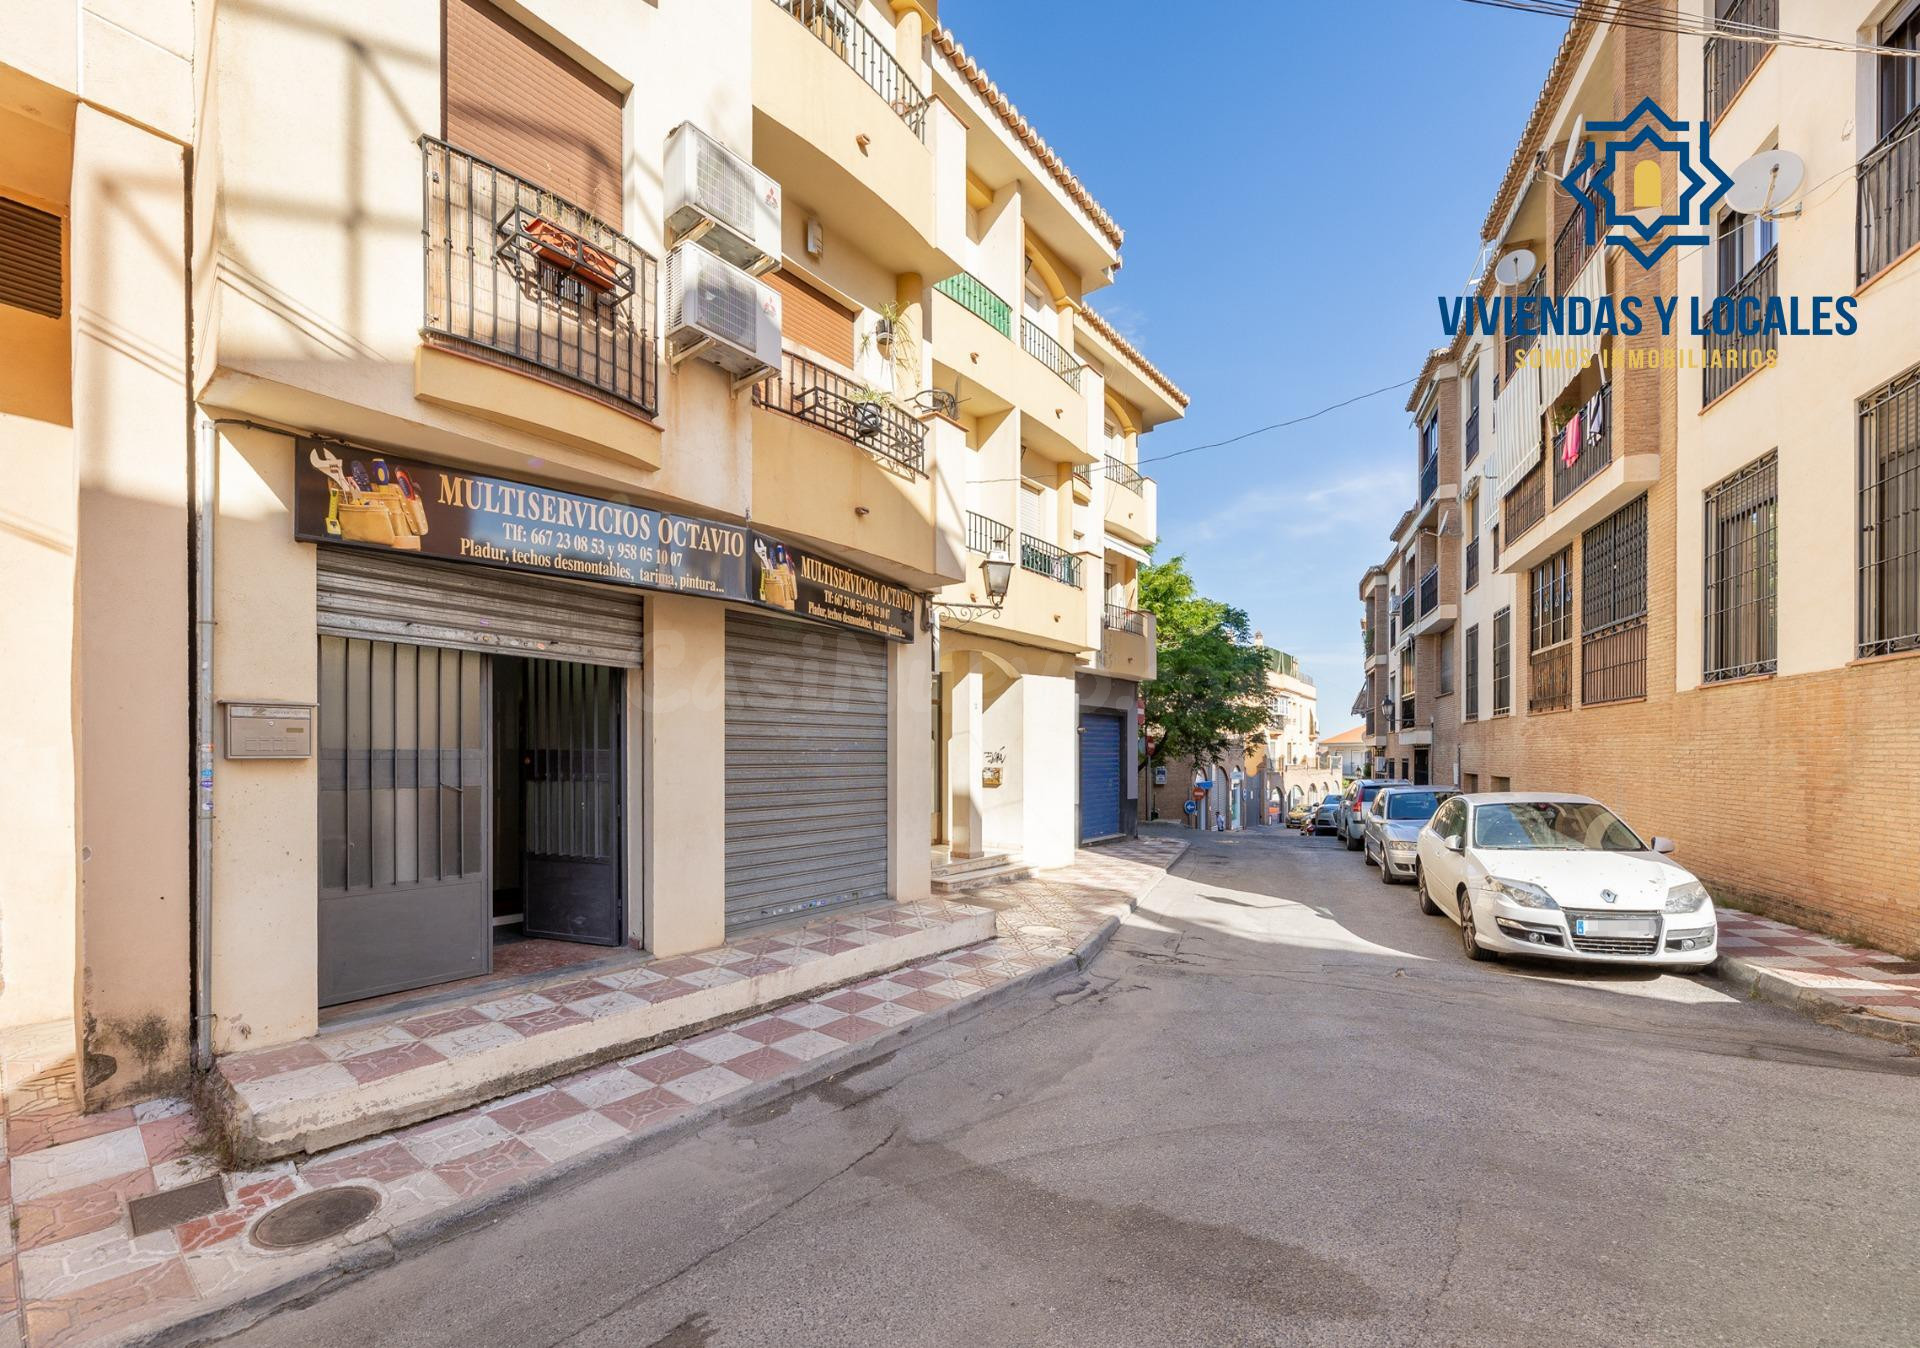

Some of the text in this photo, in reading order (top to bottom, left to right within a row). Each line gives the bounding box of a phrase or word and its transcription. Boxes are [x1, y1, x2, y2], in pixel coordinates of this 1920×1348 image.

[438, 473, 745, 557] MULTISERVICIOS OCTAVIO
[460, 537, 724, 593] Pladur, techos desmontables, tarima, pintura...
[502, 522, 683, 568] Tlf: 667 23 08 53 y 958 05 10 07
[801, 555, 913, 612] MULTISERVICIOS OCTAVIO
[834, 592, 843, 606] 667
[843, 595, 850, 608] 23
[827, 607, 842, 622] techos
